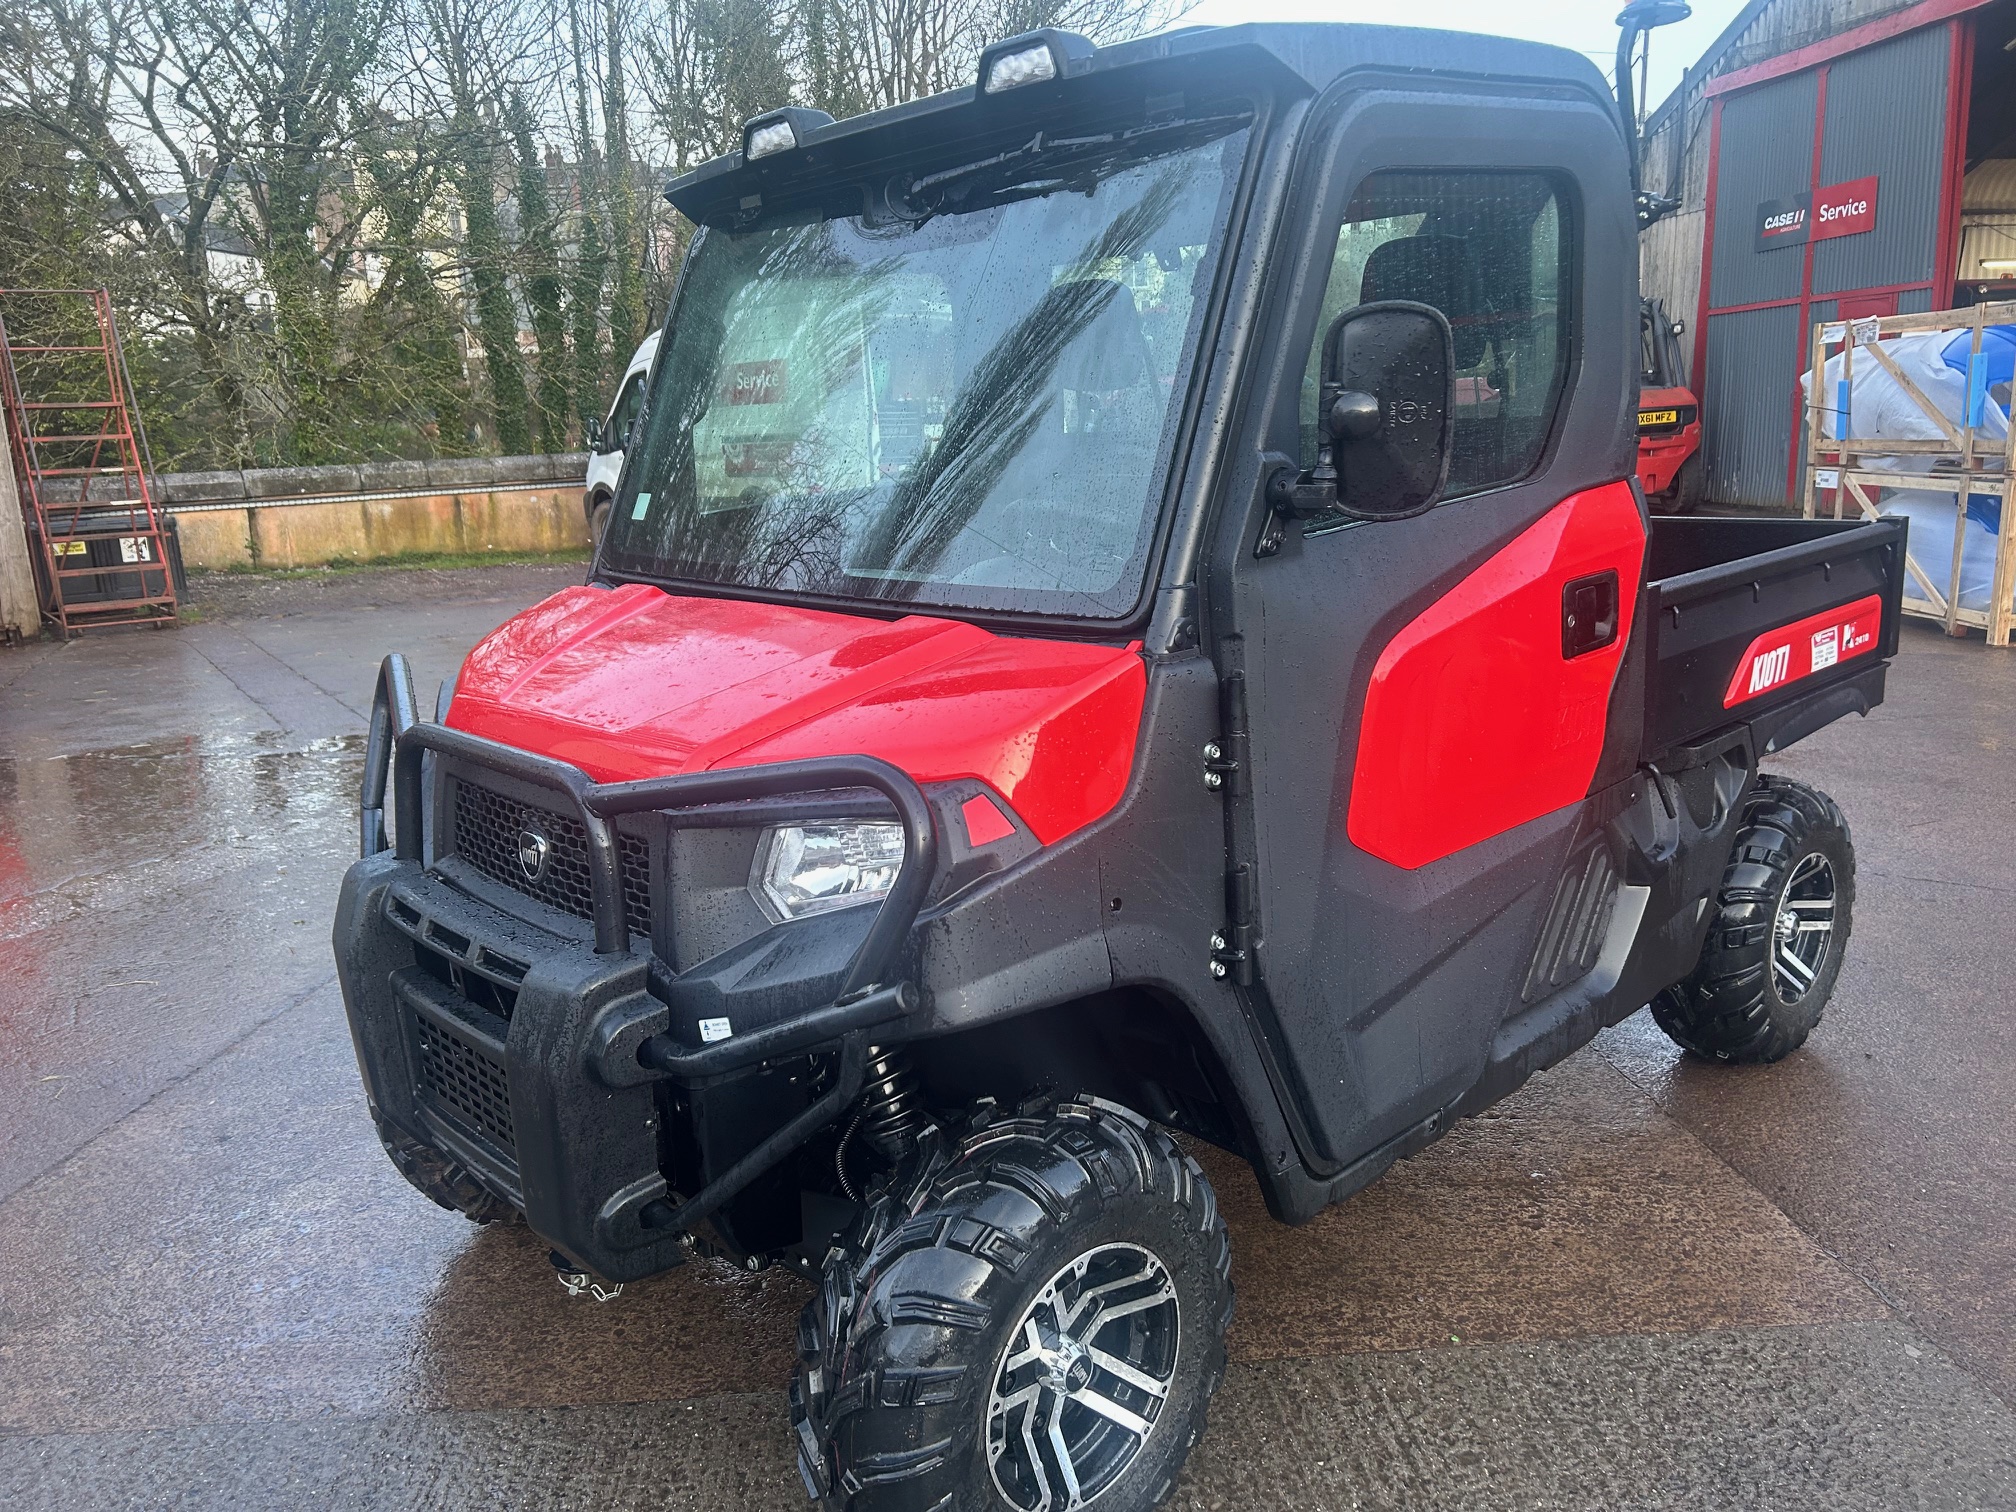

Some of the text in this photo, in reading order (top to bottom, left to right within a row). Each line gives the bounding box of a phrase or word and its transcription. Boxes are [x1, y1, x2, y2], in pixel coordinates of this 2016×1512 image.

[1764, 211, 1795, 230] CASE
[1819, 198, 1867, 222] Service
[736, 369, 780, 390] Service
[1748, 644, 1791, 694] KIOTI
